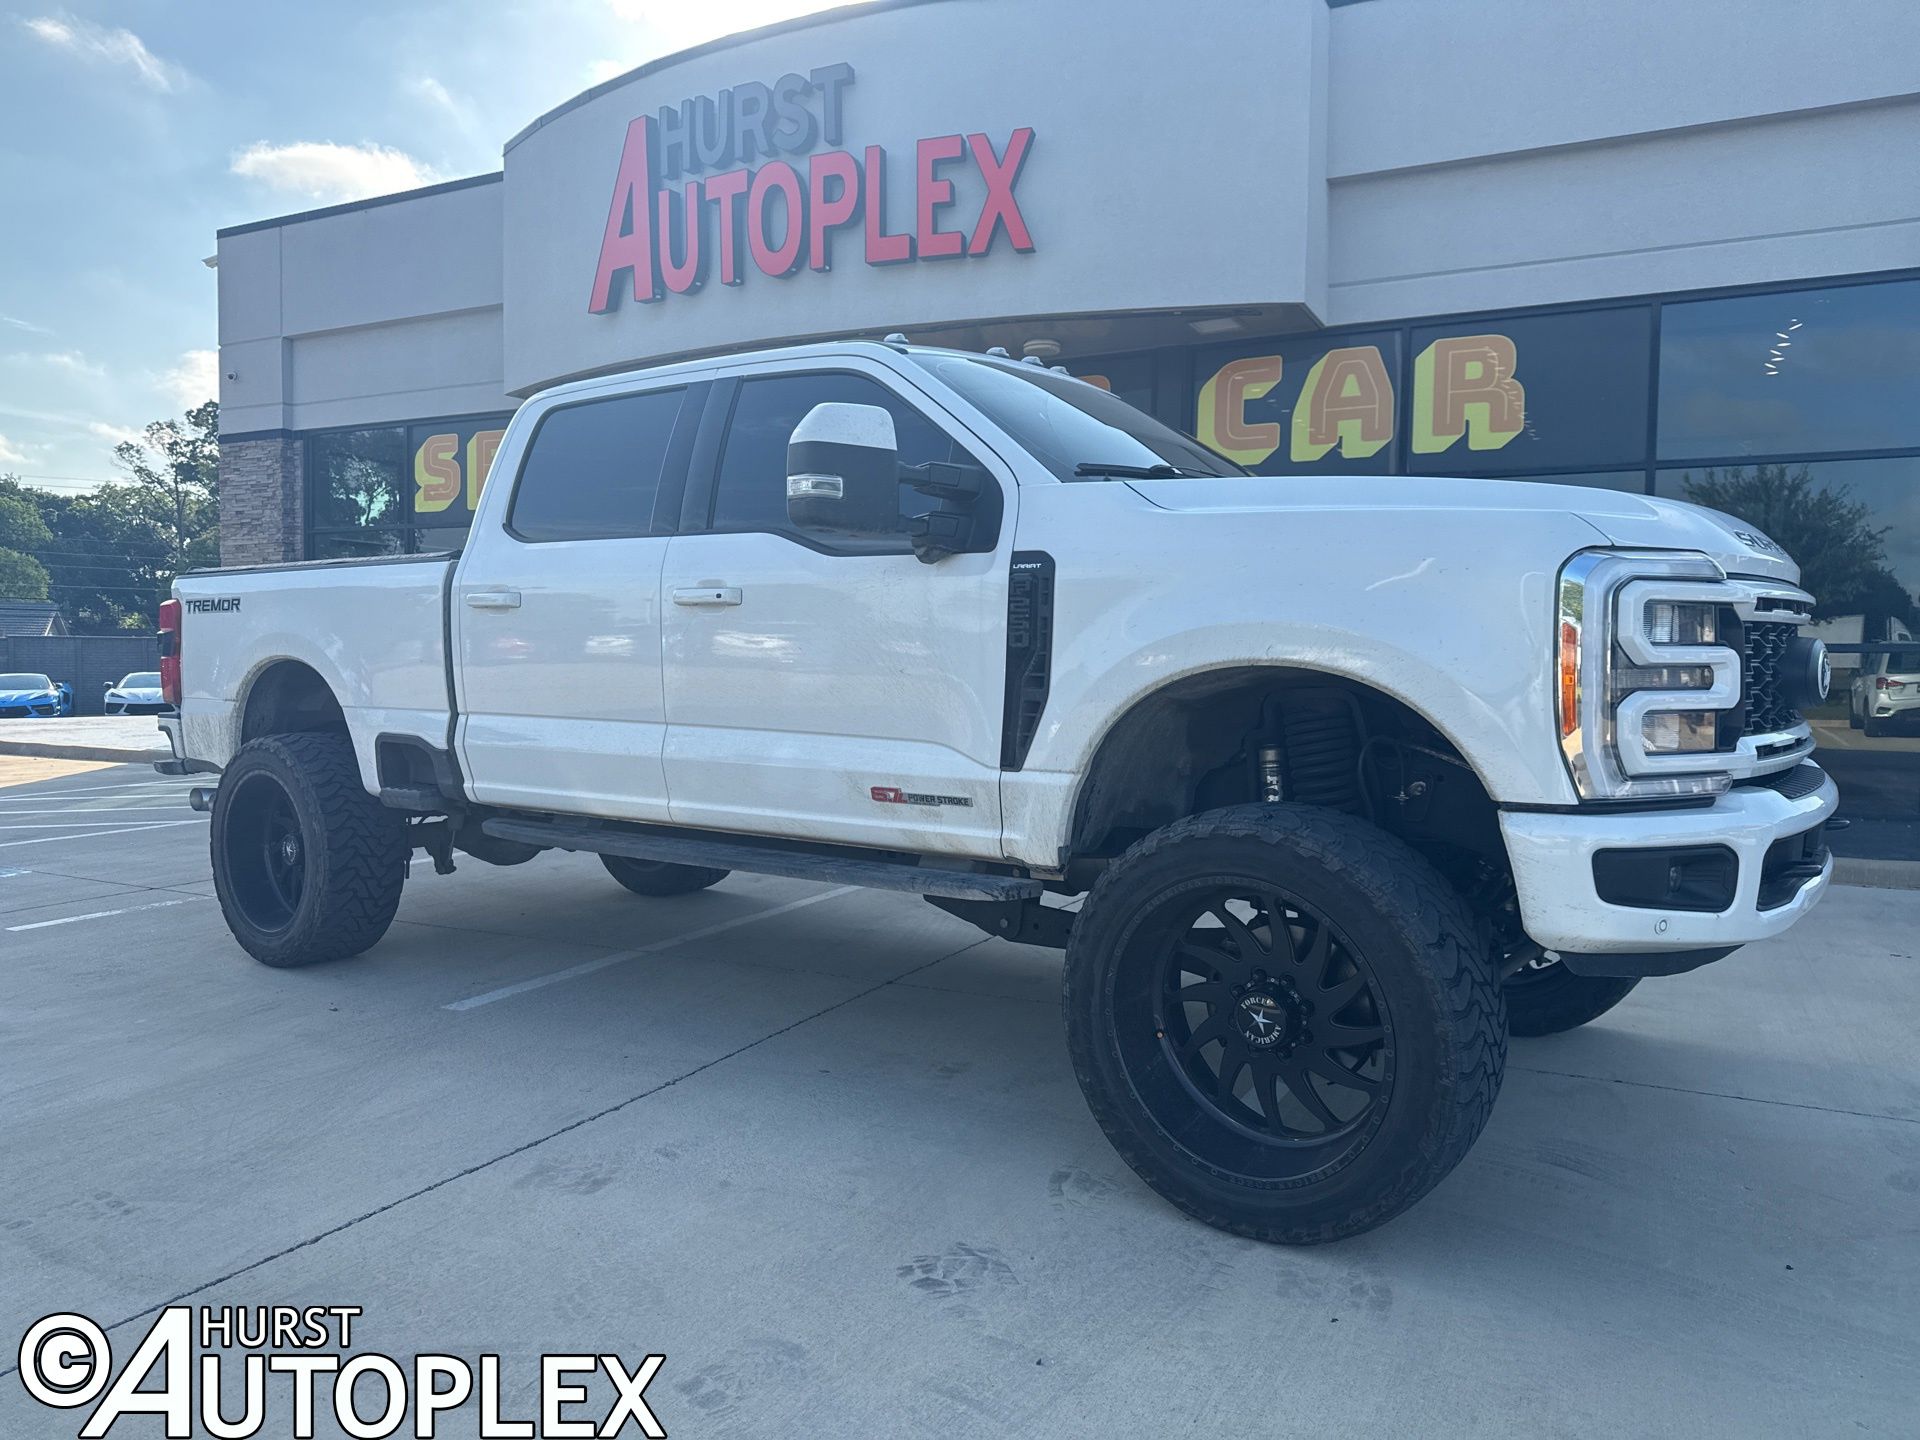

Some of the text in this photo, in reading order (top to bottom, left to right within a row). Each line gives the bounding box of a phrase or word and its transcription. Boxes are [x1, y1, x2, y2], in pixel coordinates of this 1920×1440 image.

[658, 61, 855, 181] HURST
[588, 114, 1037, 315] AUTOPLEX
[1197, 334, 1526, 465] CAR
[185, 599, 241, 614] TREMOR
